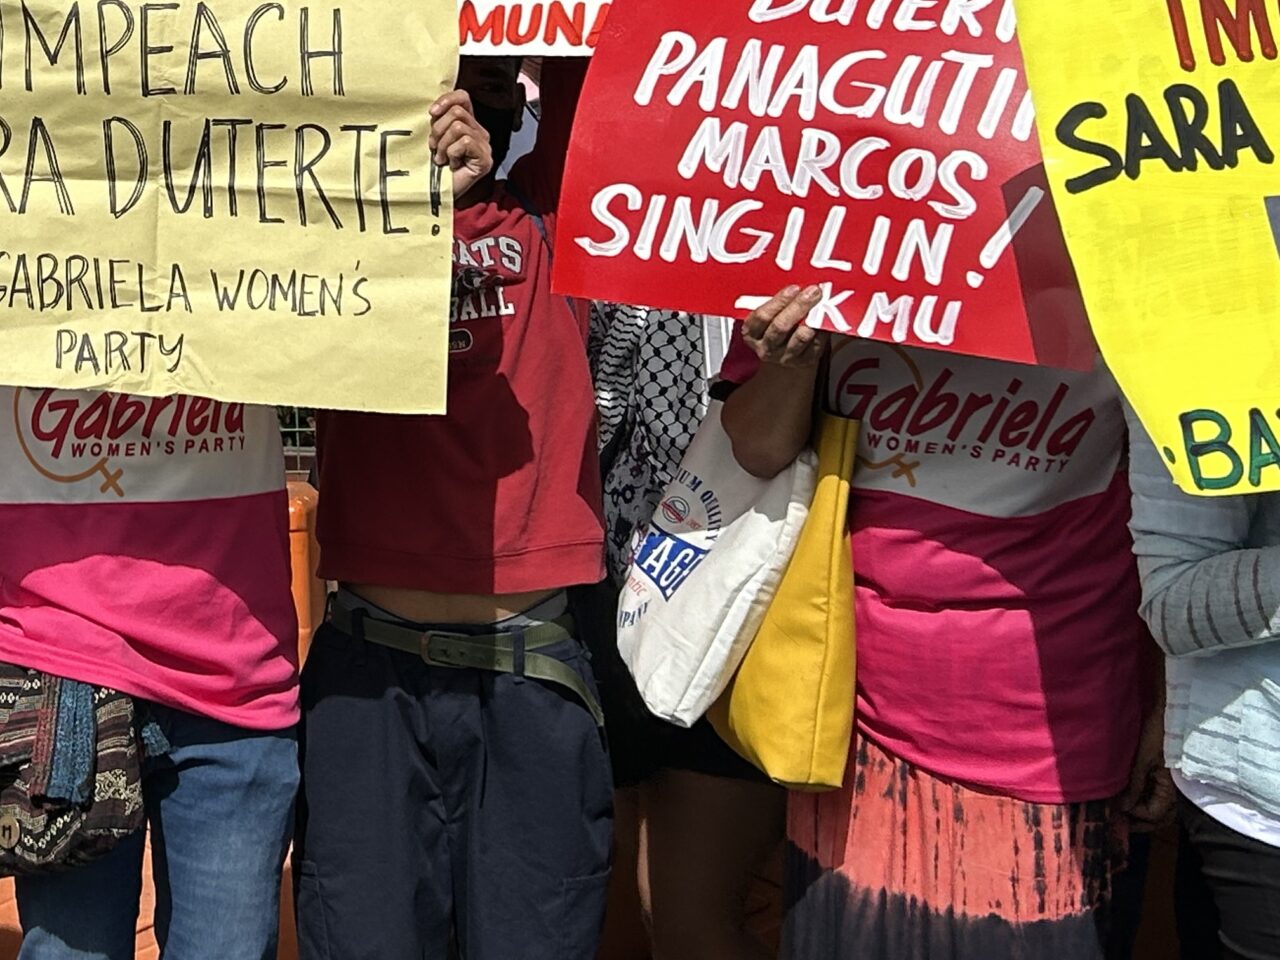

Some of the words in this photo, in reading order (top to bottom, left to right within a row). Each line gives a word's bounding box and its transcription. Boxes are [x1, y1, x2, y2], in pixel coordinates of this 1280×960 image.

[1055, 78, 1274, 194] SARA
[102, 116, 442, 237] DUTERTE!
[677, 117, 988, 219] MARCOS
[452, 236, 522, 274] ATS
[211, 260, 371, 317] WOMEN'S
[805, 282, 961, 345] KMU
[56, 328, 186, 374] PARTY
[836, 357, 1096, 457] Gabriela
[71, 440, 175, 459] WOMEN'S
[184, 436, 245, 454] PARTY
[866, 431, 982, 459] WOMEN'S
[992, 448, 1070, 474] PARTY
